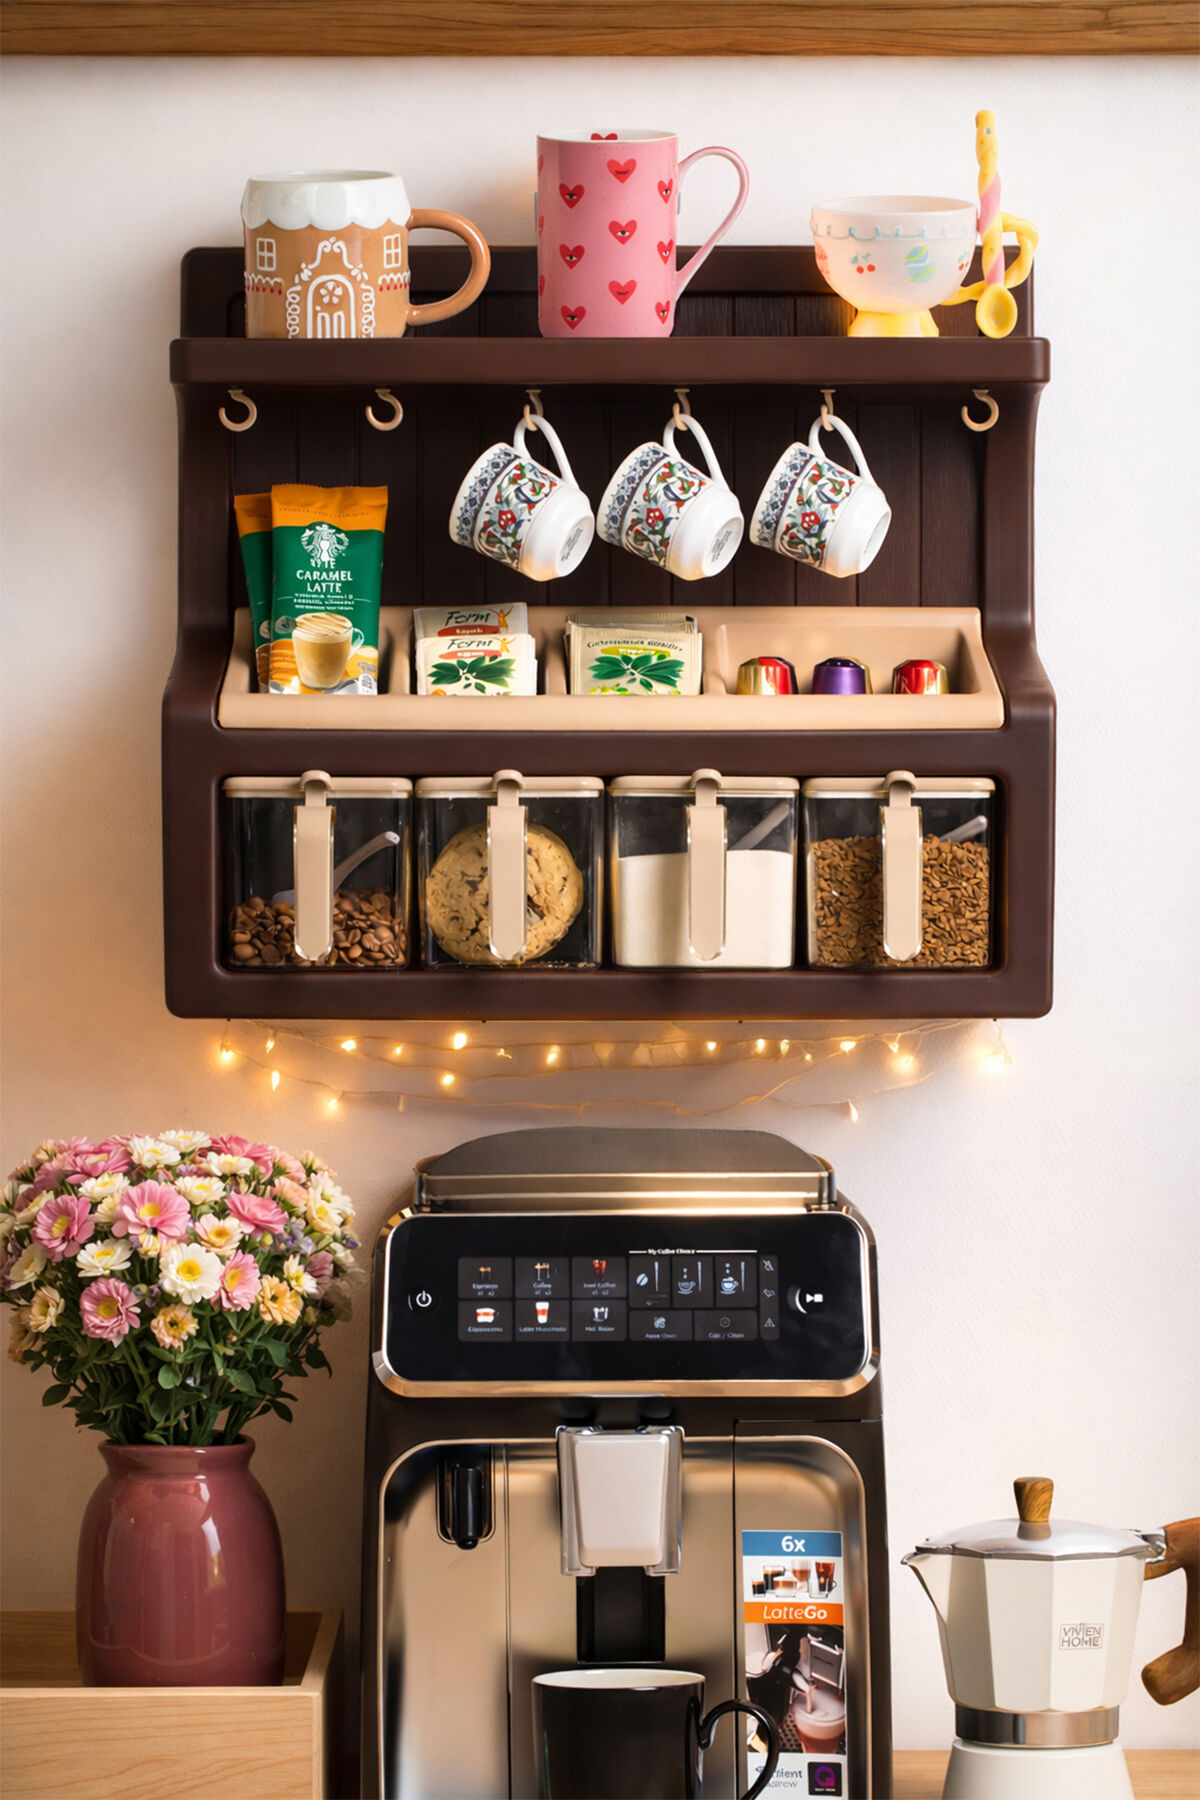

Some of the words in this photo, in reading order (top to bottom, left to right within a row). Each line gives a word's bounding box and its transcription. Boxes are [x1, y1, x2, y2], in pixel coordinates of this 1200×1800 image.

[296, 569, 353, 581] CARAMEL
[307, 582, 342, 593] LATTE
[781, 1535, 806, 1552] 6x
[763, 1605, 828, 1620] LatteGo
[1061, 1636, 1100, 1648] HOME
